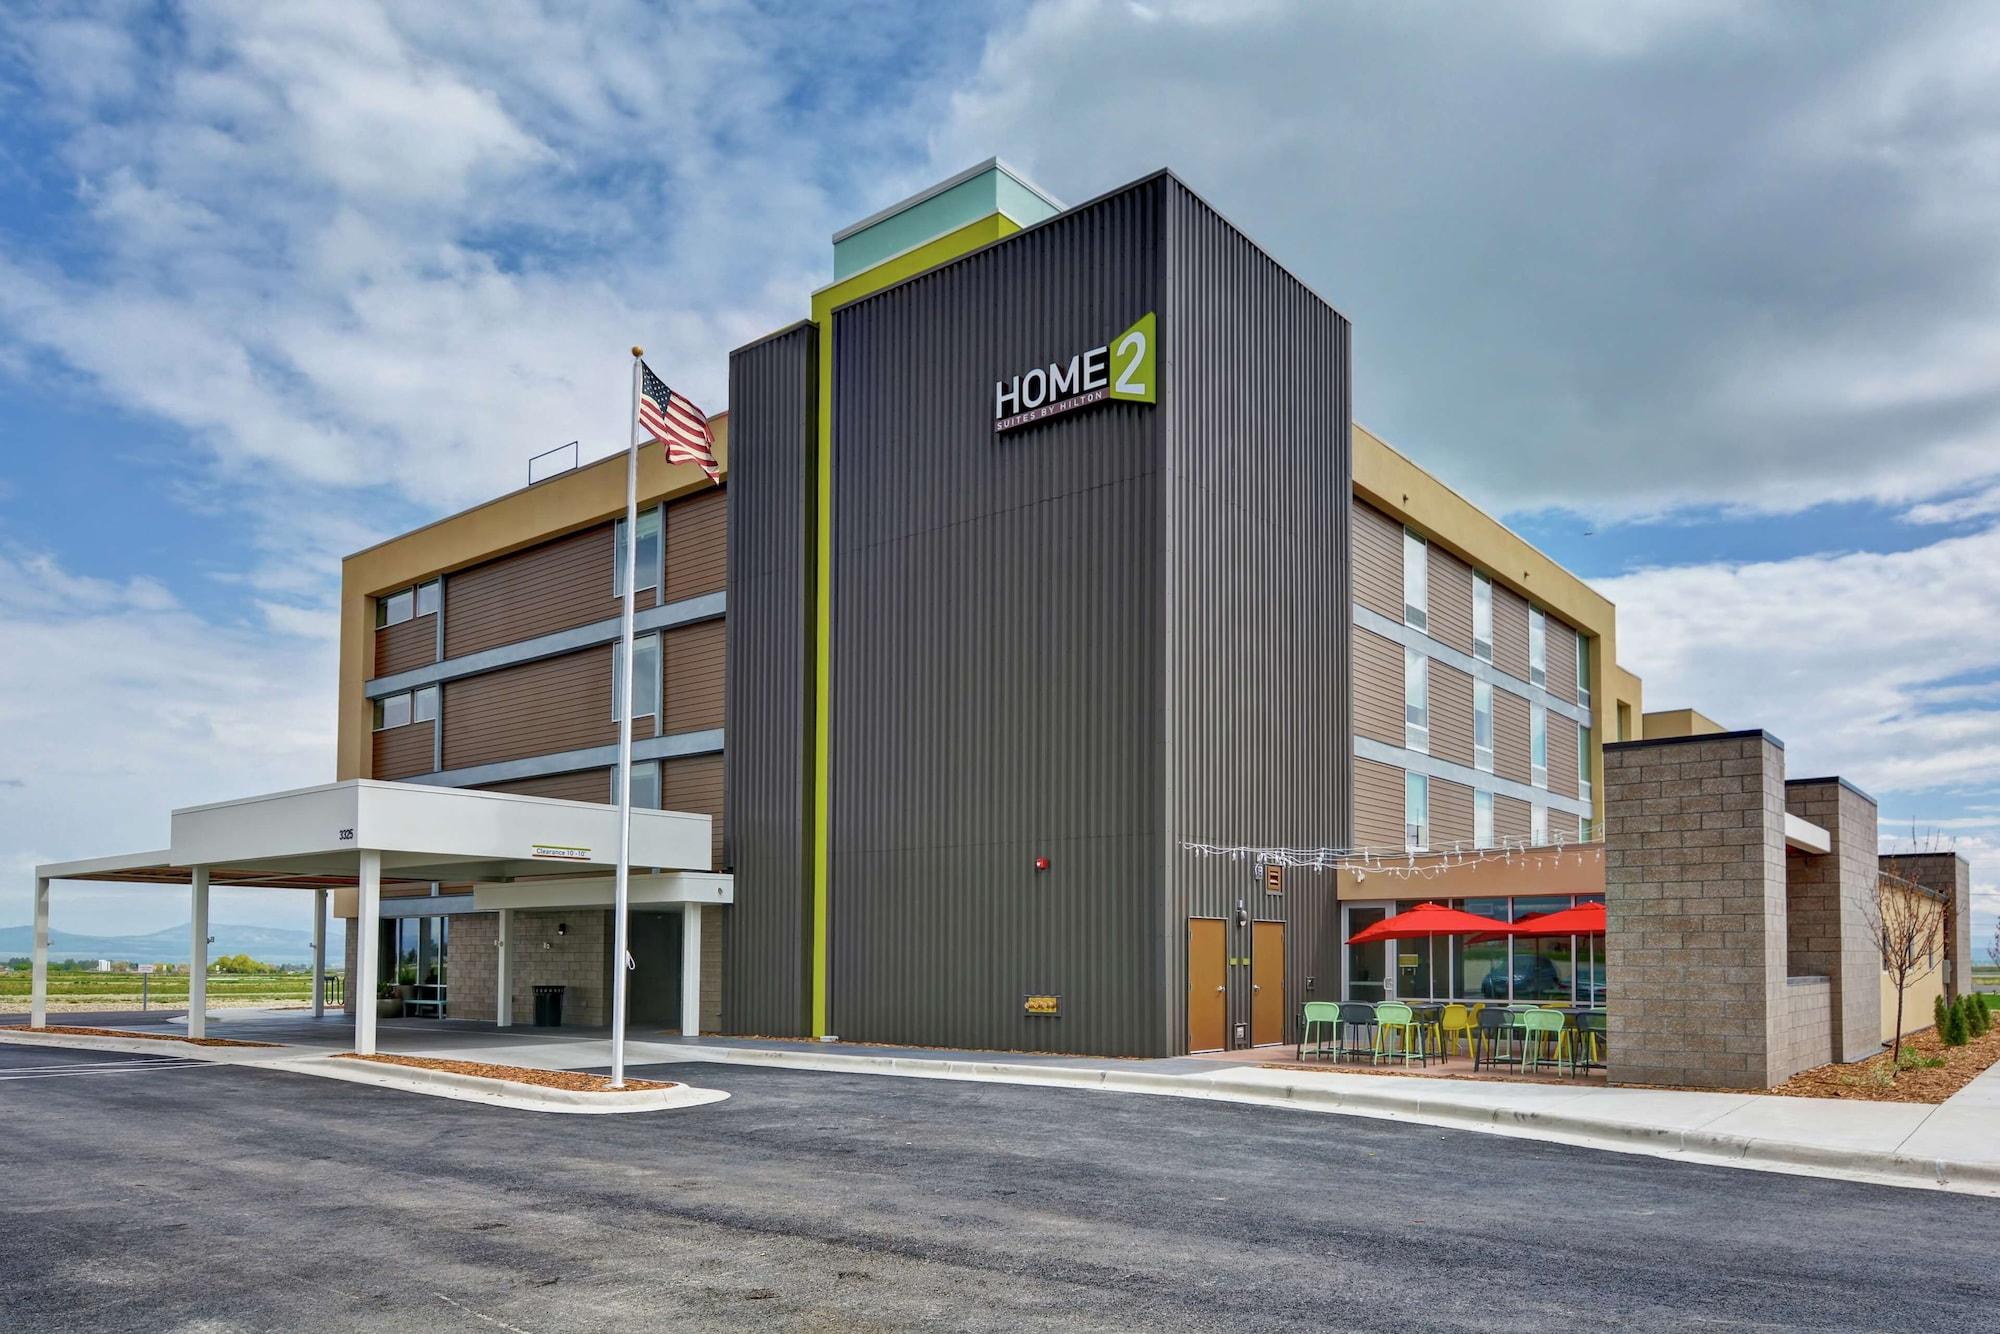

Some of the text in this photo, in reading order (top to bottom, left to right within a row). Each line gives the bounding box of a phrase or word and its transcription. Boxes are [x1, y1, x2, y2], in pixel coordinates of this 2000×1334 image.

[997, 391, 1102, 431] SUITES BY HILTON
[339, 828, 354, 840] 3325
[536, 848, 566, 856] Clearance
